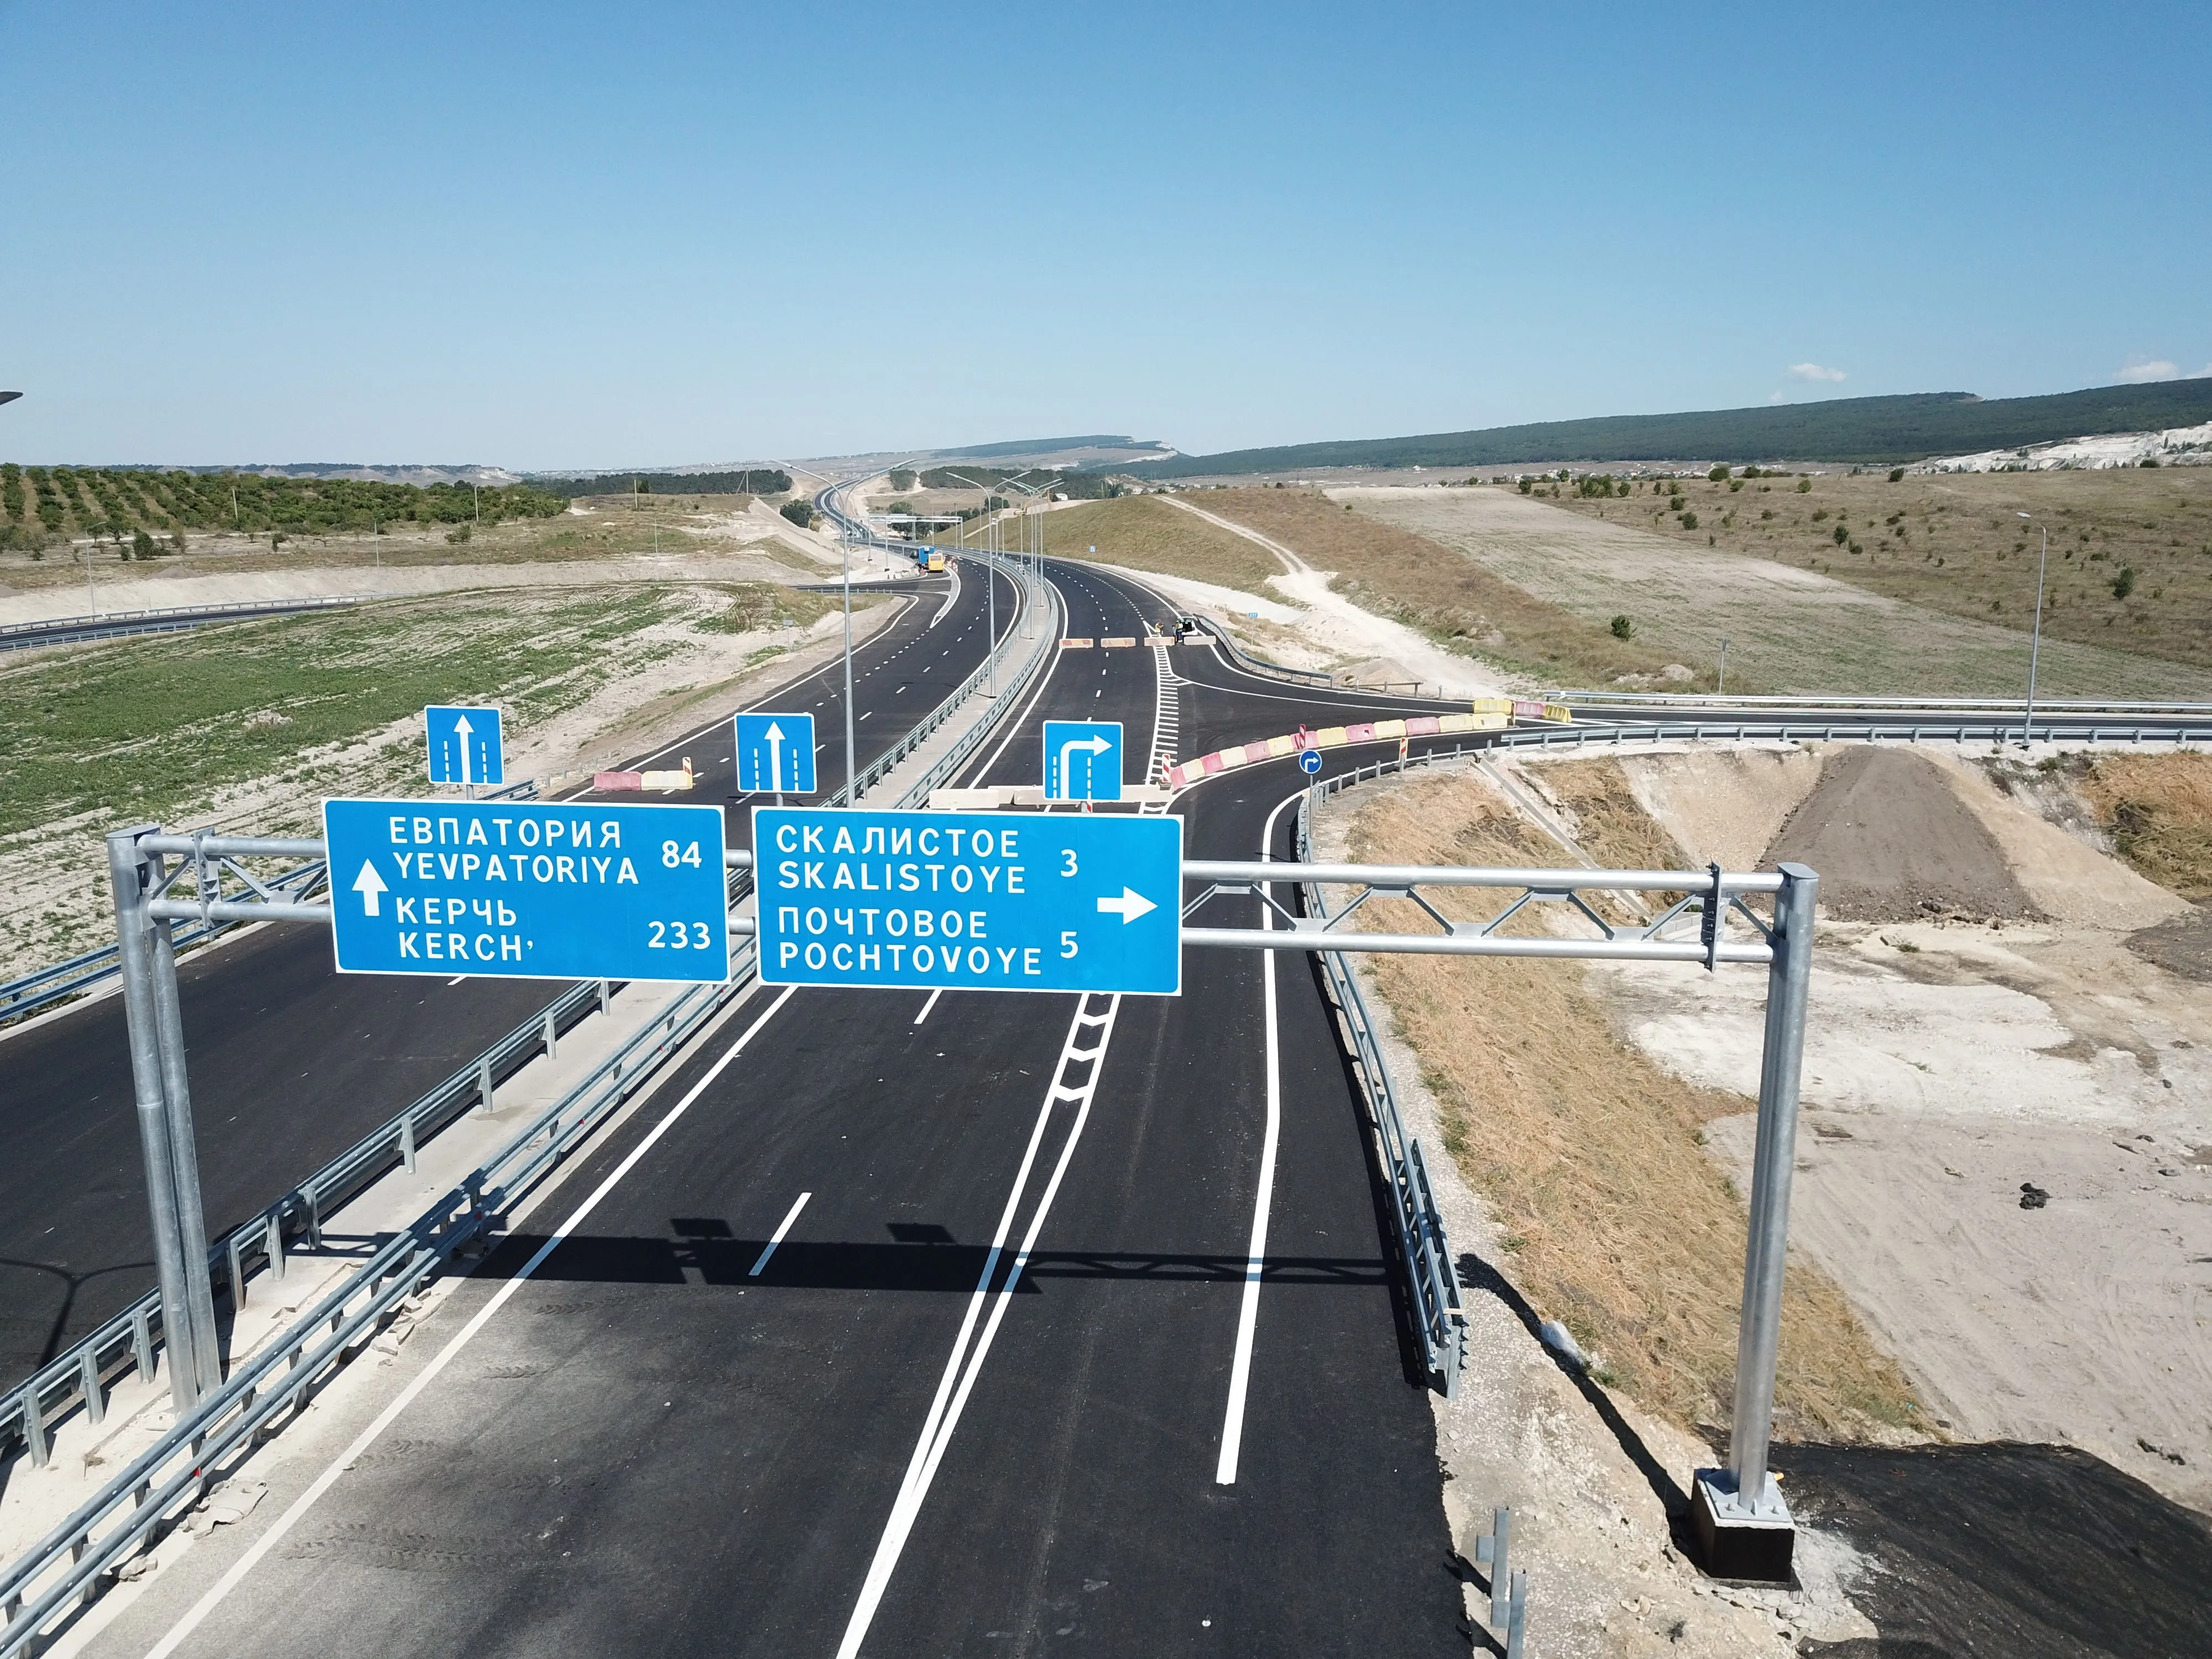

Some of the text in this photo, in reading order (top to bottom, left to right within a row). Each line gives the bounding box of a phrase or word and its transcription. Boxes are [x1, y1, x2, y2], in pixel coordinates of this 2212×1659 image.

[389, 816, 620, 848] ЕВПАТОРИЯ
[776, 825, 1018, 858] СКАЛИСТОЕ
[393, 852, 639, 884] YEVPATORIYA
[662, 840, 702, 868] 84
[1061, 849, 1078, 877] 3
[778, 860, 1025, 894] SKALISTOYE
[396, 897, 517, 926] КЕРЧЬ
[779, 906, 987, 938] ПОЧТОВОЕ
[648, 921, 711, 950] 233
[1061, 931, 1078, 958] 5
[780, 942, 1041, 975] POCHTOVOYE
